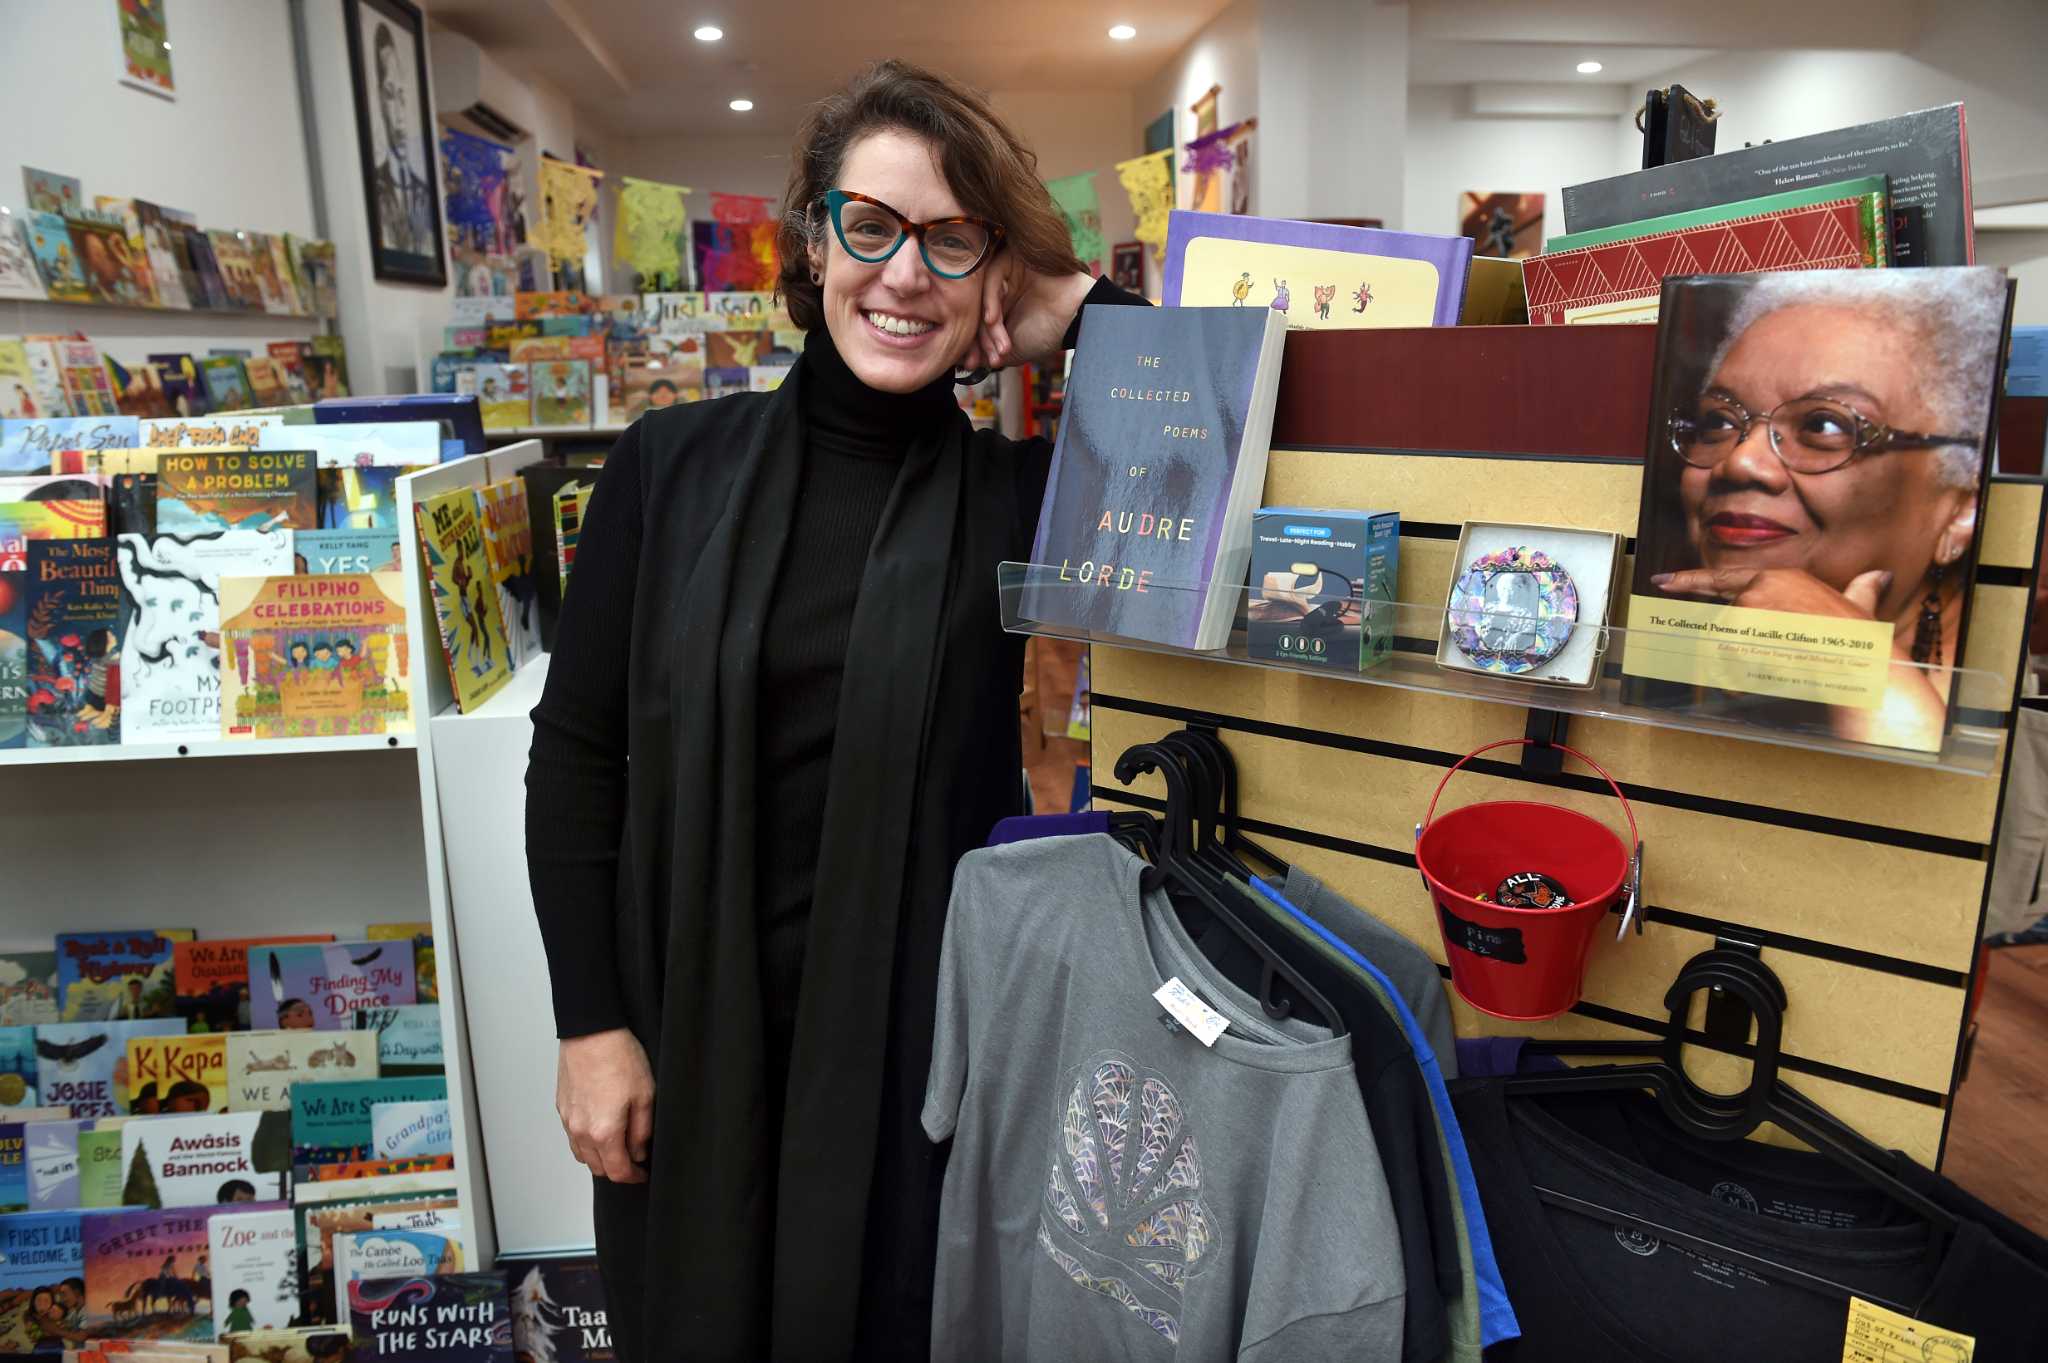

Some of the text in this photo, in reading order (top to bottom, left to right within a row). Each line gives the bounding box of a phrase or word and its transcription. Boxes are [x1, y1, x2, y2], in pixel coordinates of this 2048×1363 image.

[1136, 356, 1161, 369] THE
[1111, 387, 1191, 403] COLLECTED
[1163, 425, 1208, 440] POEMS
[166, 454, 306, 472] HOW TO SOLVE
[1129, 466, 1147, 478] OF
[186, 473, 290, 490] A PROBLEM
[1097, 510, 1194, 542] AUDRE
[319, 555, 370, 574] YES
[1059, 559, 1153, 593] LORDE
[277, 581, 360, 598] FILIPINO
[253, 601, 385, 619] CELEBRATIONS
[1650, 615, 1875, 650] The Collected Poems of Lucille Clifton 1965-2010
[1507, 873, 1540, 888] ALL
[309, 968, 403, 995] Finding My
[323, 992, 391, 1016] Dance
[47, 1080, 108, 1102] JOSIE
[242, 1087, 270, 1101] WE
[302, 1099, 324, 1117] We
[331, 1098, 355, 1115] Are
[162, 1157, 248, 1178] Bannock
[8, 1227, 49, 1248] FIRST
[221, 1226, 256, 1248] Zoe
[365, 1245, 402, 1258] Canoe
[371, 1301, 495, 1329] RUNS WITH
[376, 1327, 494, 1355] THE STARS
